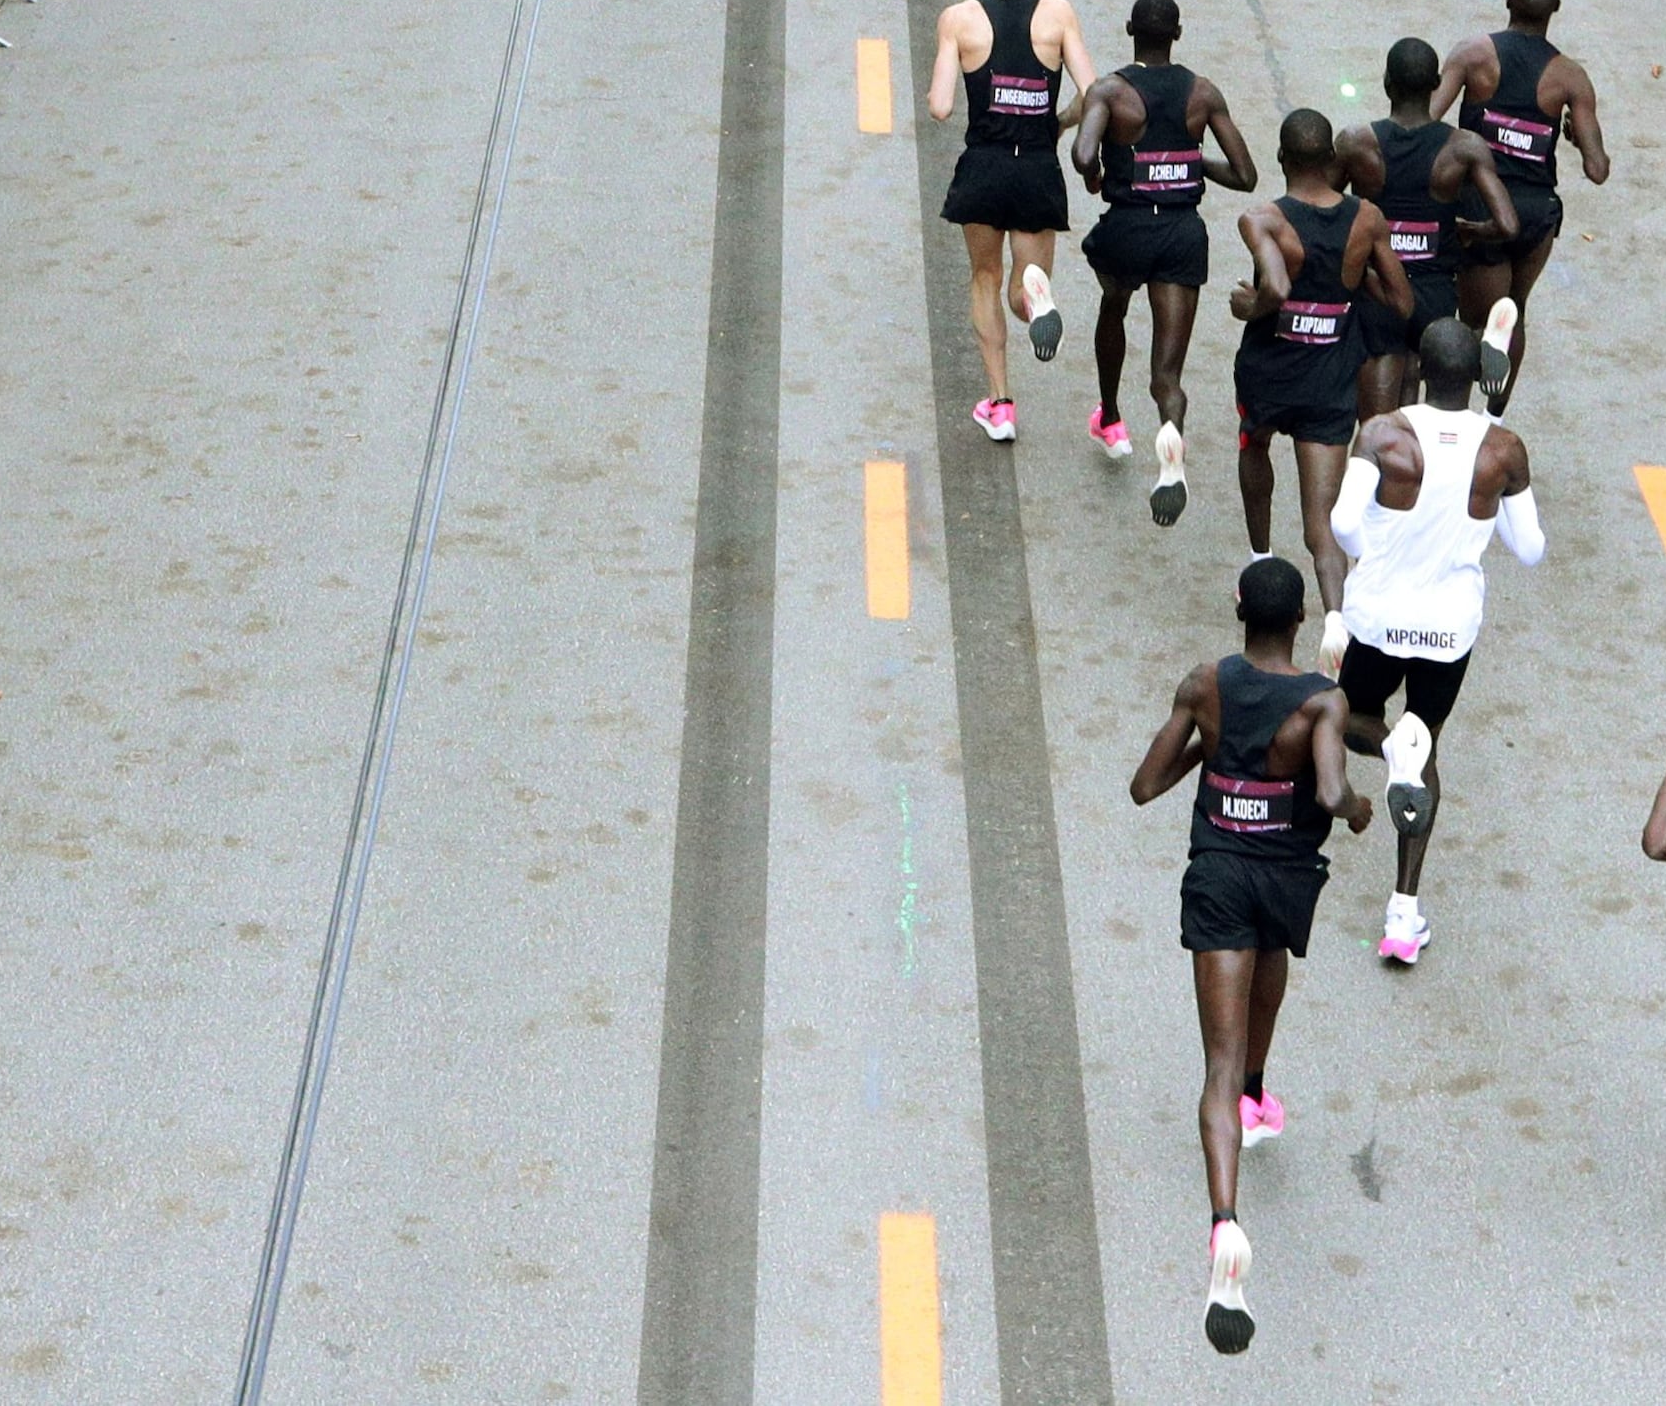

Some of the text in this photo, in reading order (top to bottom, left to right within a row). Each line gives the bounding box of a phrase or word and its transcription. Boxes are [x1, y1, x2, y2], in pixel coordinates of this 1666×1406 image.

[1497, 127, 1533, 151] V.CHUMO
[1148, 163, 1188, 181] P.CHELIMO
[1386, 628, 1457, 649] KIPCHOGE
[1222, 795, 1269, 820] M.KOECH
